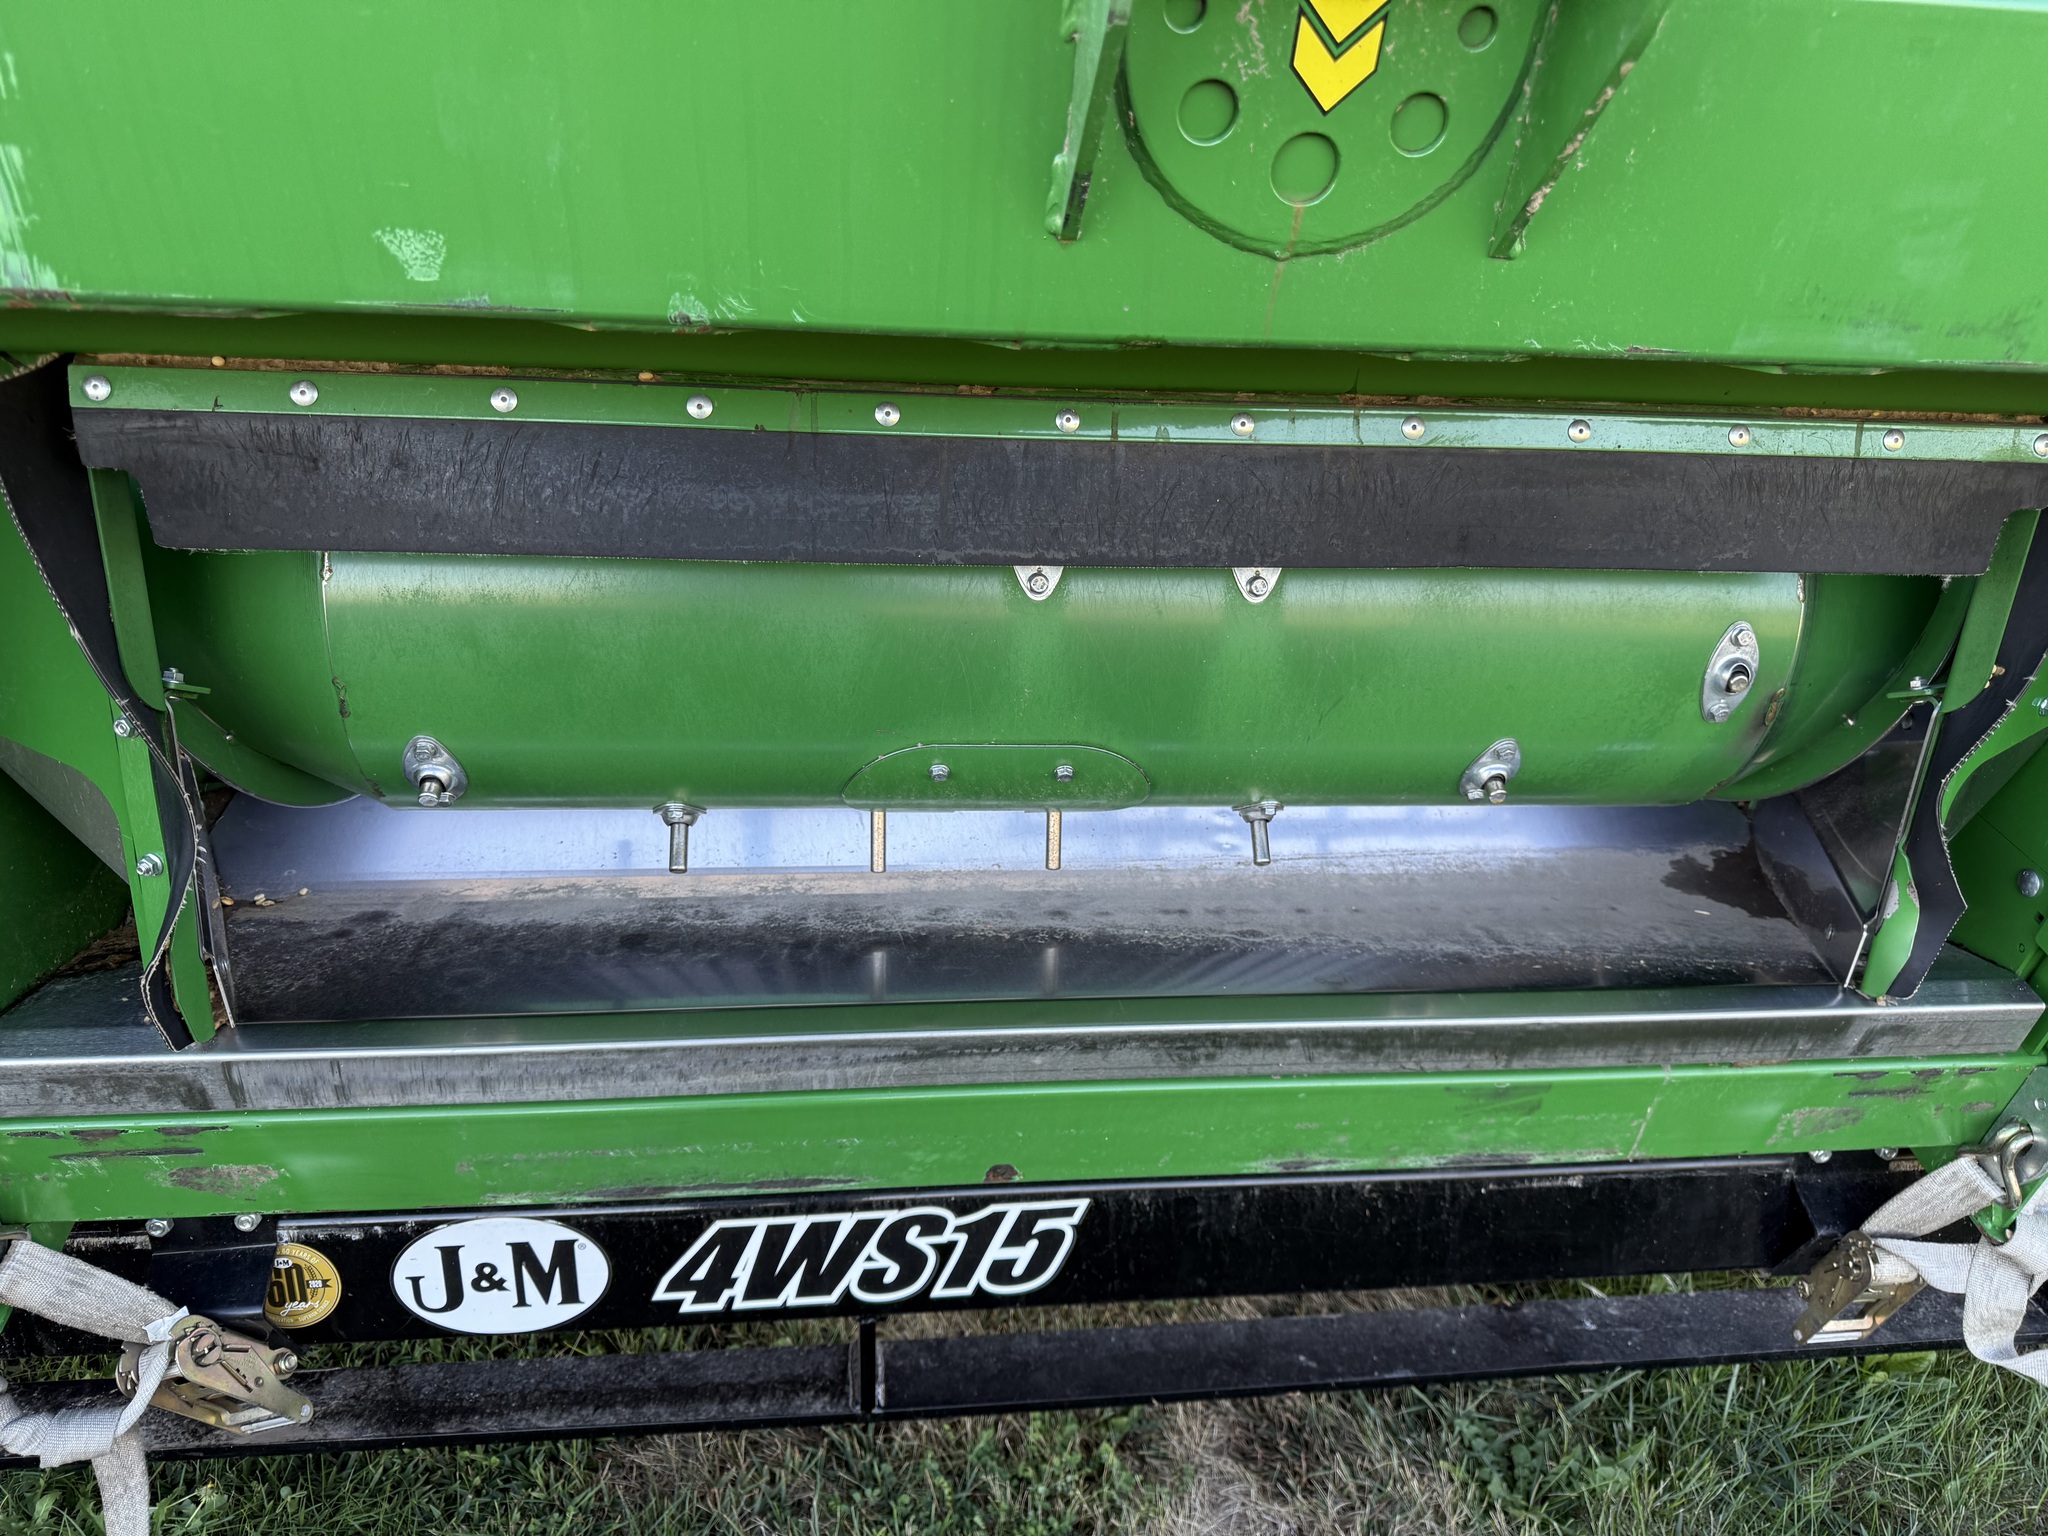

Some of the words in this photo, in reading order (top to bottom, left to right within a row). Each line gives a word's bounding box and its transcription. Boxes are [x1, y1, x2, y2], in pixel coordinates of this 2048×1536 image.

[292, 1249, 311, 1261] YEARS
[311, 1257, 320, 1265] OF
[653, 1198, 1091, 1313] 4WS15
[268, 1263, 309, 1308] 60
[280, 1300, 320, 1316] years
